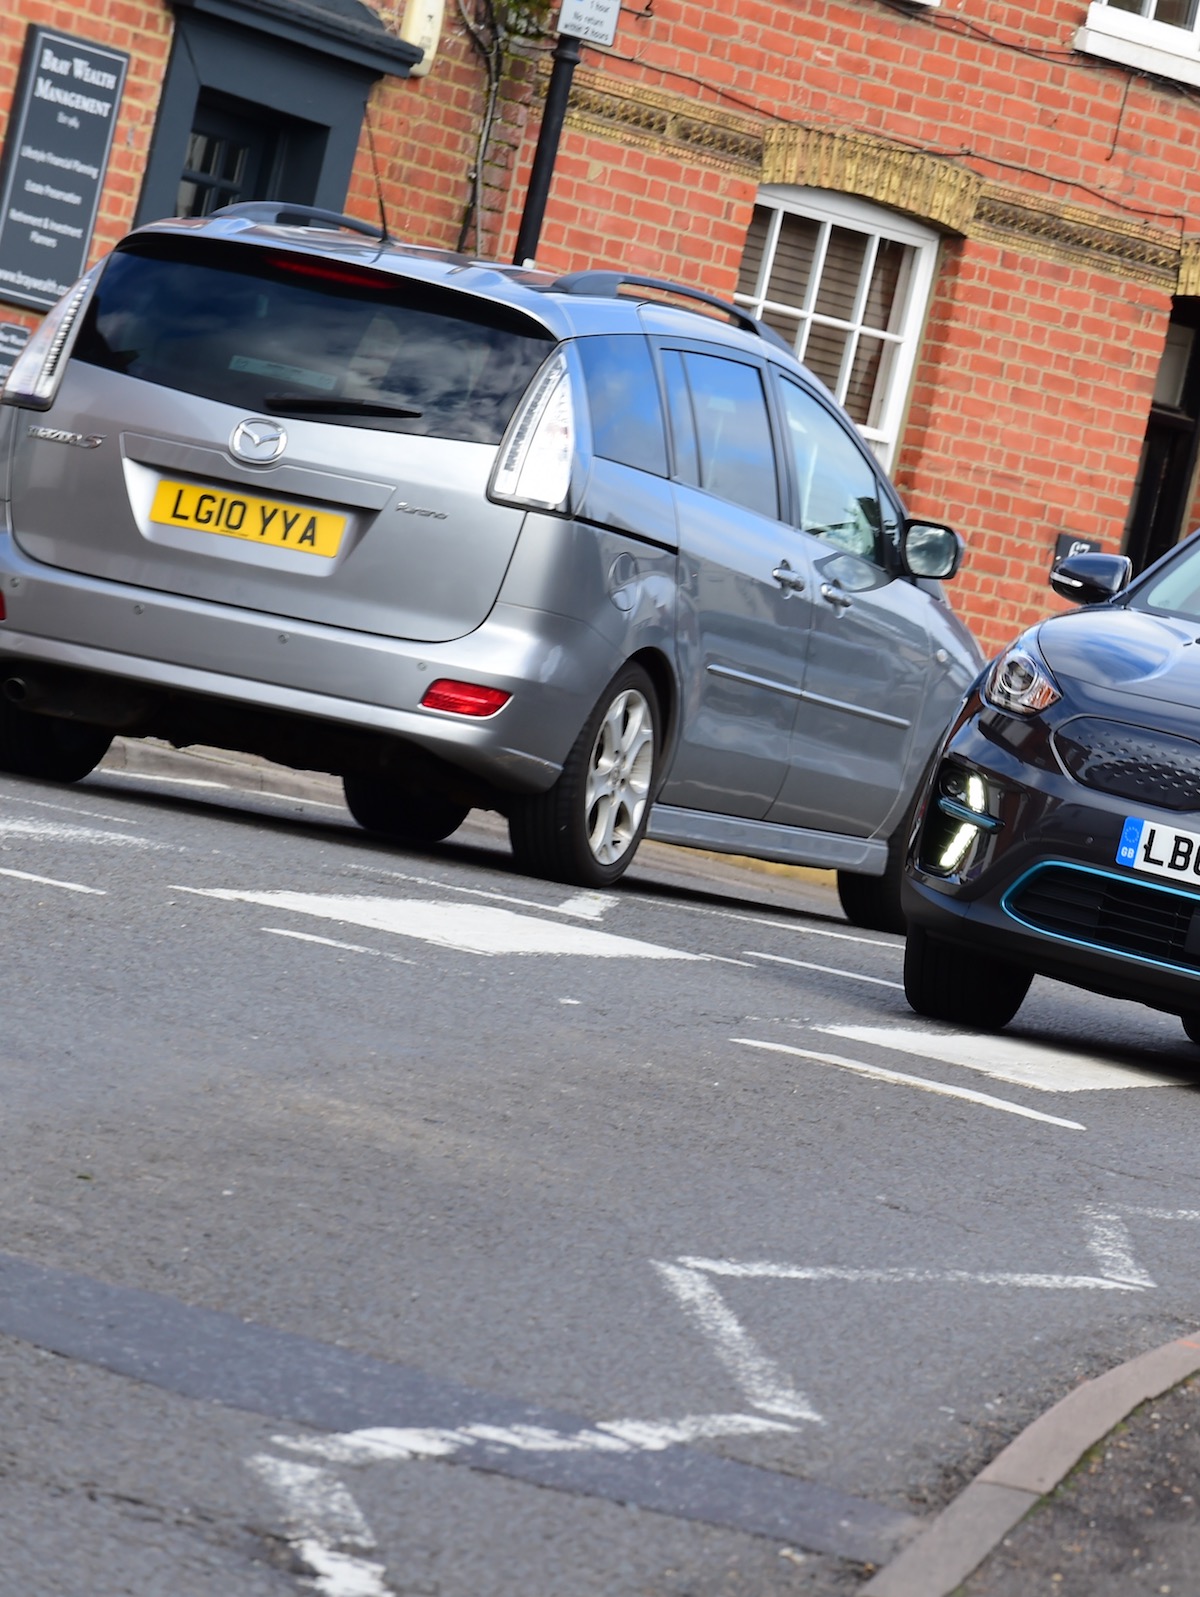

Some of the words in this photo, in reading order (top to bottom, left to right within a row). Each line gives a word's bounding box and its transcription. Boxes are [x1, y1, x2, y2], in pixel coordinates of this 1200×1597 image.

[33, 76, 112, 117] MANAGEMENT
[171, 489, 247, 531] LG10
[259, 505, 318, 547] YYA
[1121, 846, 1134, 859] GB
